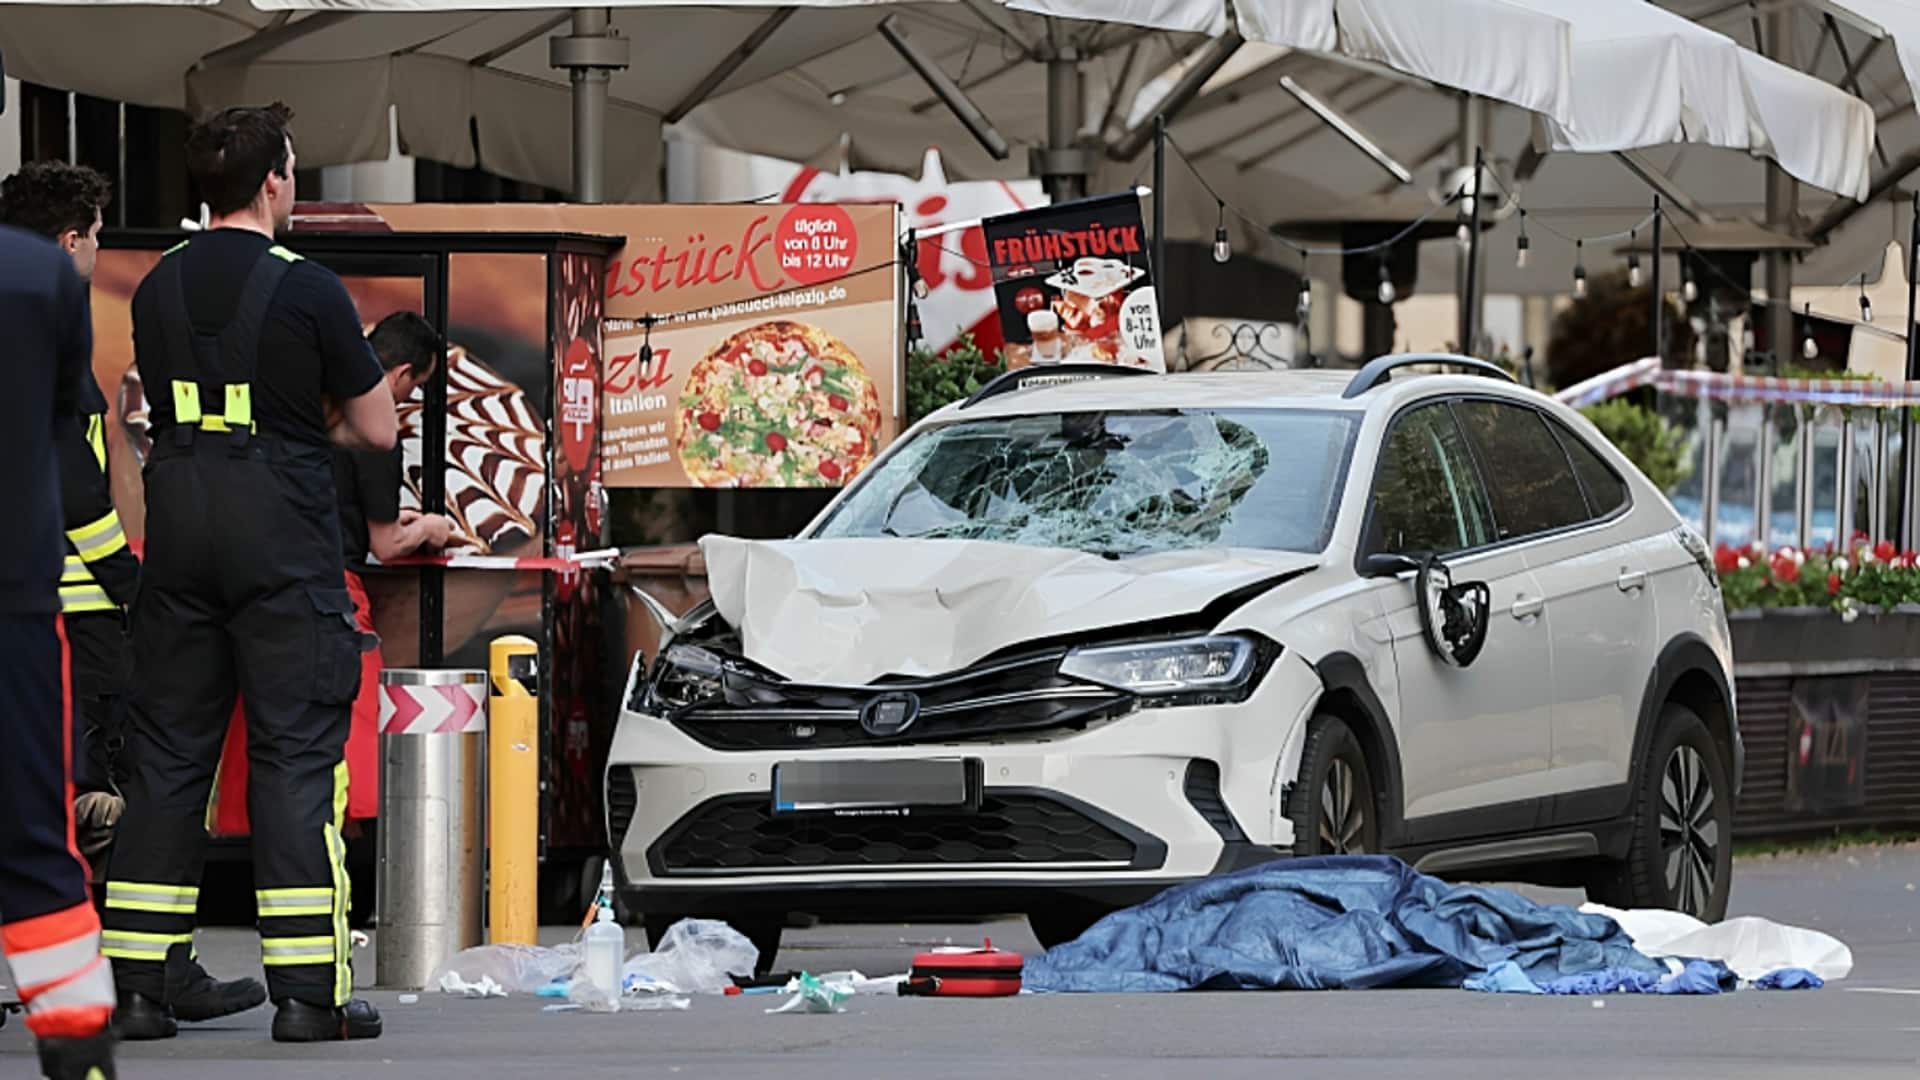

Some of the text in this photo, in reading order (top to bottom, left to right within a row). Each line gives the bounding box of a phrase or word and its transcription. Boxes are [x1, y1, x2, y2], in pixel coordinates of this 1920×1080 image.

[785, 238, 809, 251] von
[824, 235, 849, 250] Uhr
[993, 223, 1140, 265] FRÜHSTÜCK
[782, 252, 849, 268] bis 12 Uhr
[1129, 303, 1152, 315] von
[1125, 316, 1153, 333] 8-12
[1133, 333, 1157, 350] Uhr
[609, 392, 667, 416] Italien
